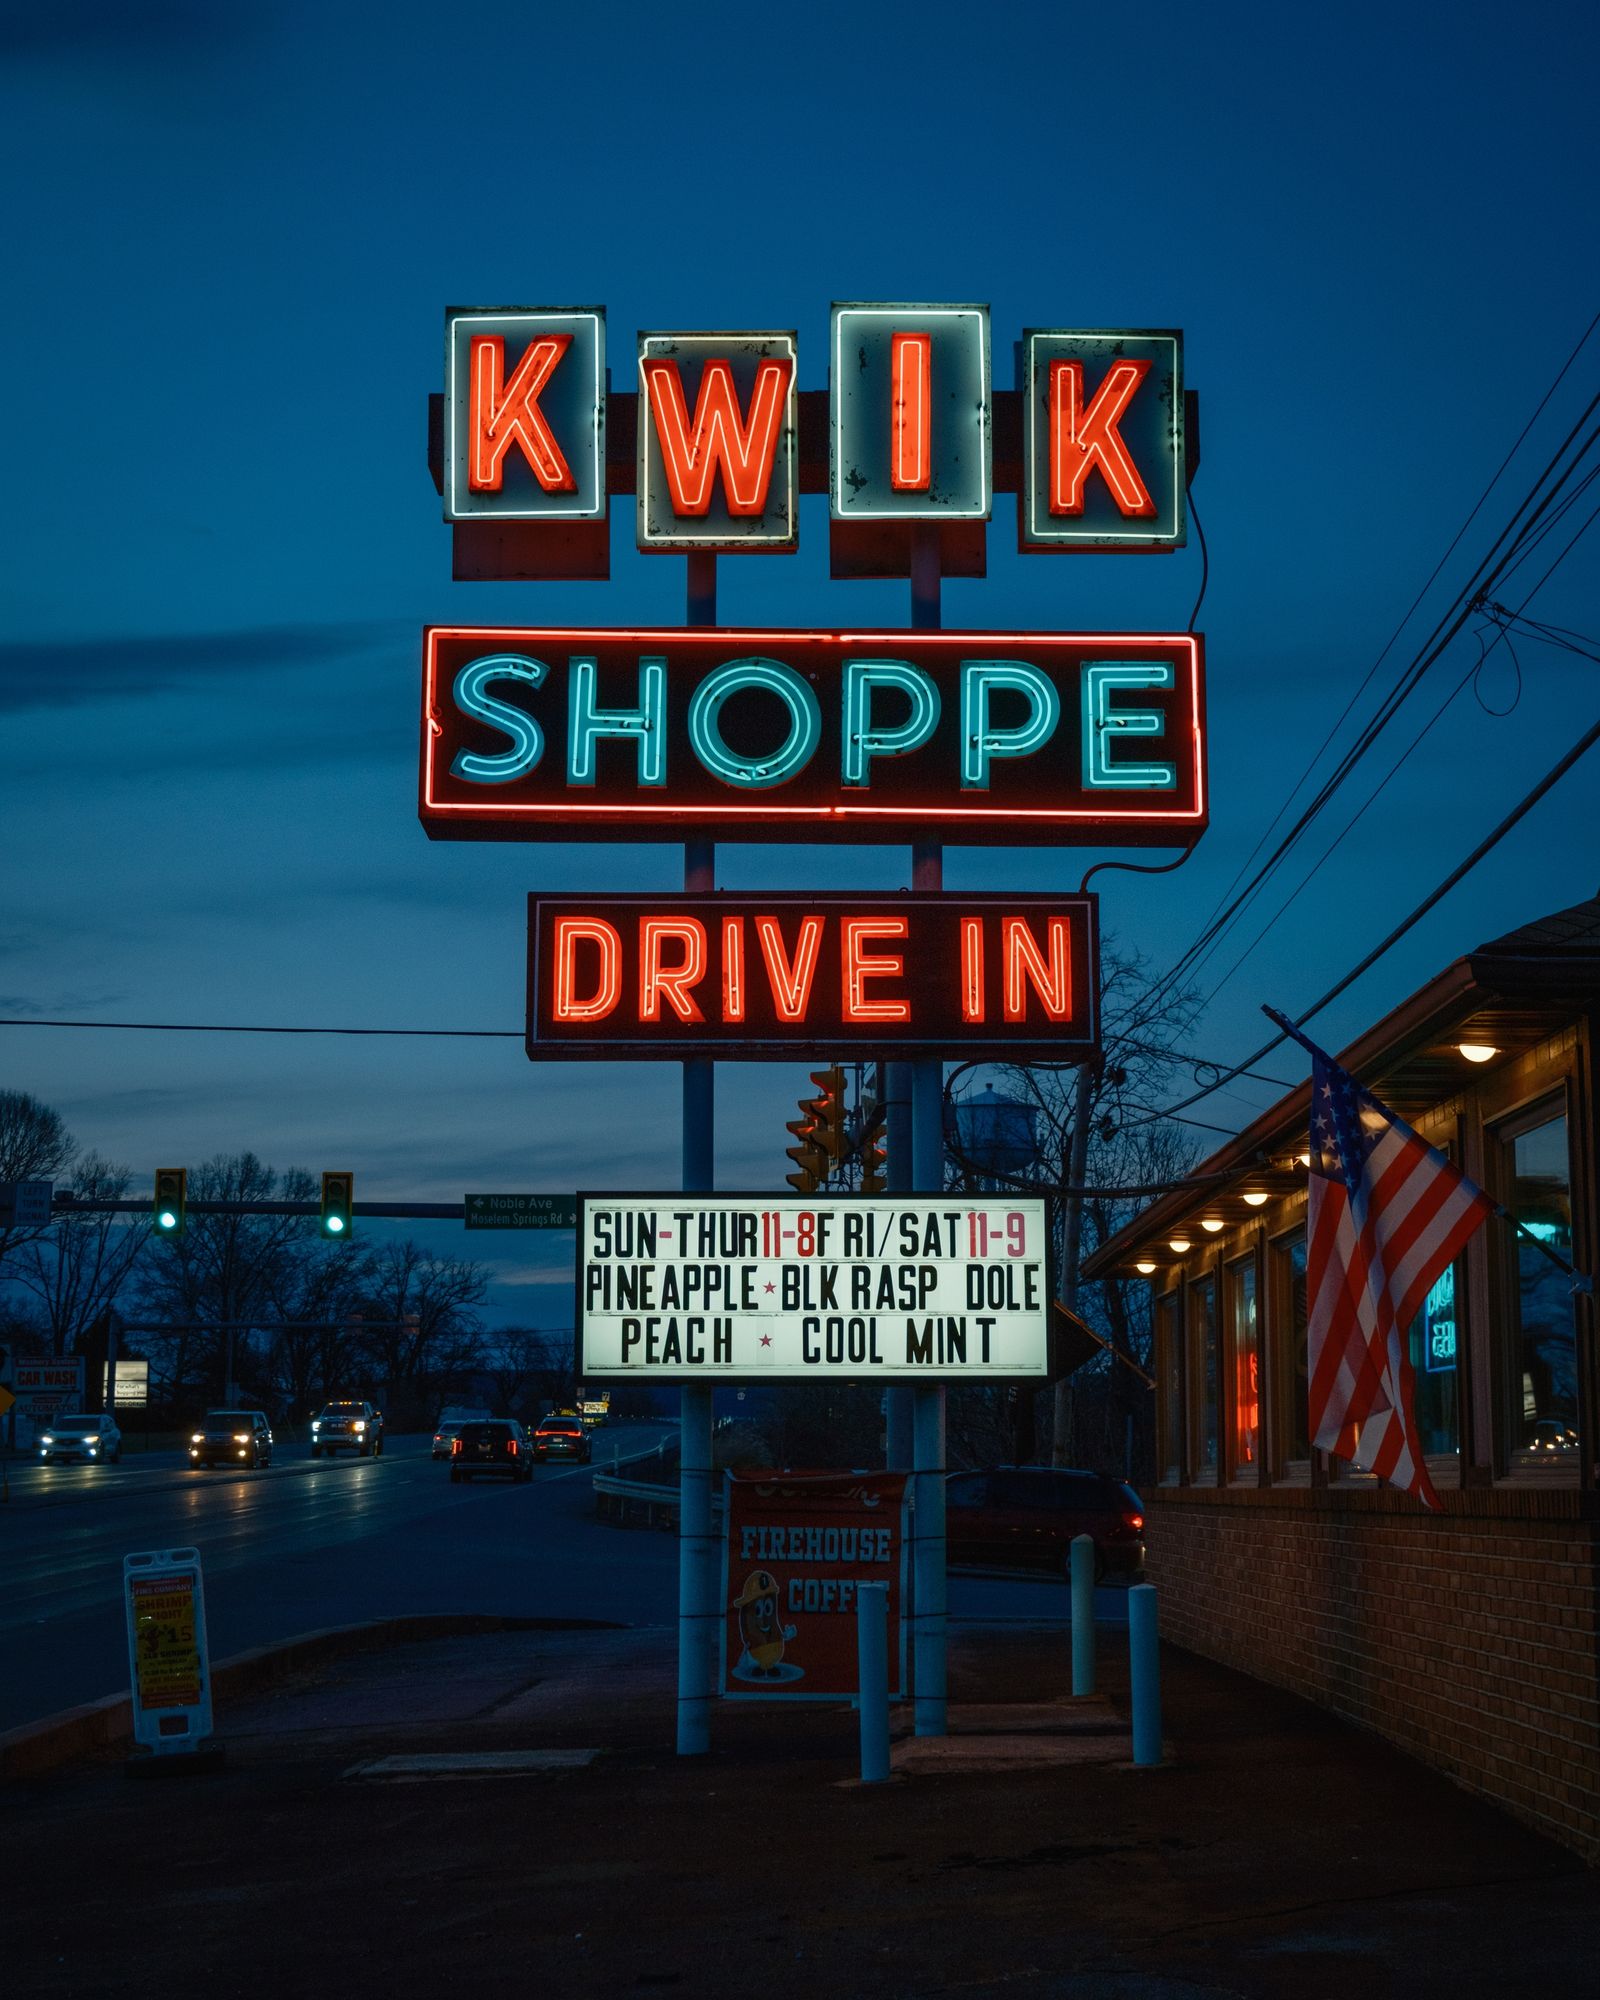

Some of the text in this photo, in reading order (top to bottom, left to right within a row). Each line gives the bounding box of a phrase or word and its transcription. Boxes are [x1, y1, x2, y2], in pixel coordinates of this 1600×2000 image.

[469, 332, 1158, 518] KWIK
[449, 653, 1177, 790] SHOPPE
[553, 916, 1073, 1022] DRIVE IN
[490, 1197, 553, 1209] Noble Ave
[512, 1212, 548, 1228] Springs
[550, 1212, 563, 1225] Rd
[968, 1212, 1026, 1257] 11-9
[586, 1264, 1040, 1311] PINEAPPLE BLK RASP DOLE
[621, 1317, 996, 1364] PEACH COOL MINT
[44, 1371, 77, 1385] WASH
[740, 1526, 892, 1562] FIREHOUSE
[788, 1579, 890, 1613] COFF
